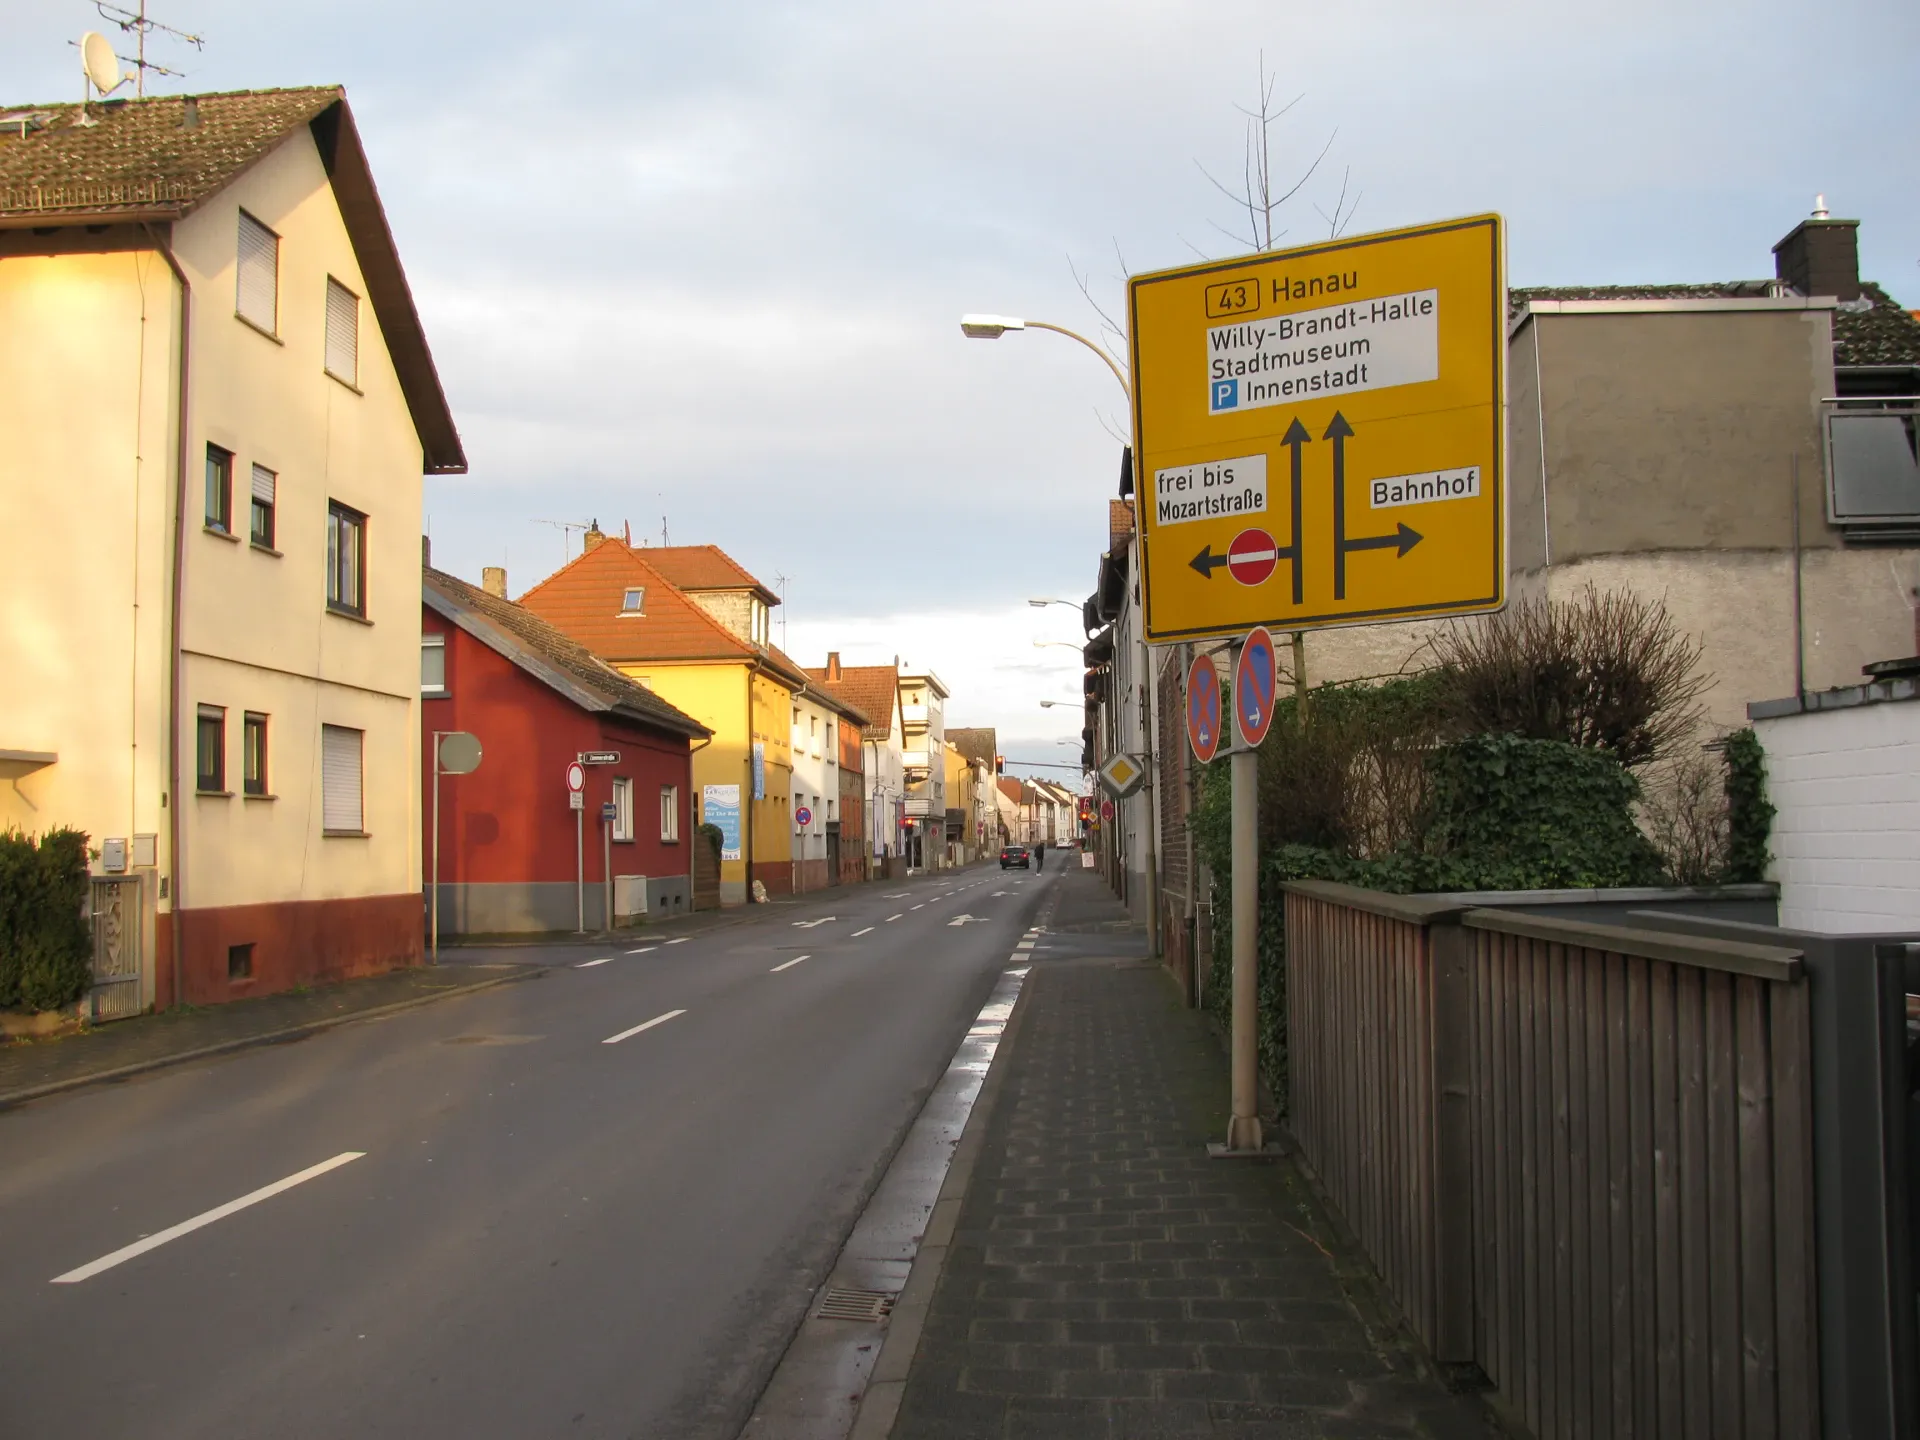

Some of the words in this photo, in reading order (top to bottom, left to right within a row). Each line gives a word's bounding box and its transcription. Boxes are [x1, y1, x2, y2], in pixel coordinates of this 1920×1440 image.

[1219, 286, 1247, 310] 43
[1272, 270, 1357, 304] Hanau
[1211, 296, 1434, 352] Willy-Brandt-Halle
[1211, 338, 1370, 380] Stadtmuseum
[1218, 384, 1232, 406] P
[1247, 363, 1368, 402] Innenstadt
[1158, 469, 1193, 494] frei
[1203, 464, 1235, 488] bis
[1373, 470, 1475, 505] Bahnhof
[1158, 489, 1263, 522] Mozartstraße
